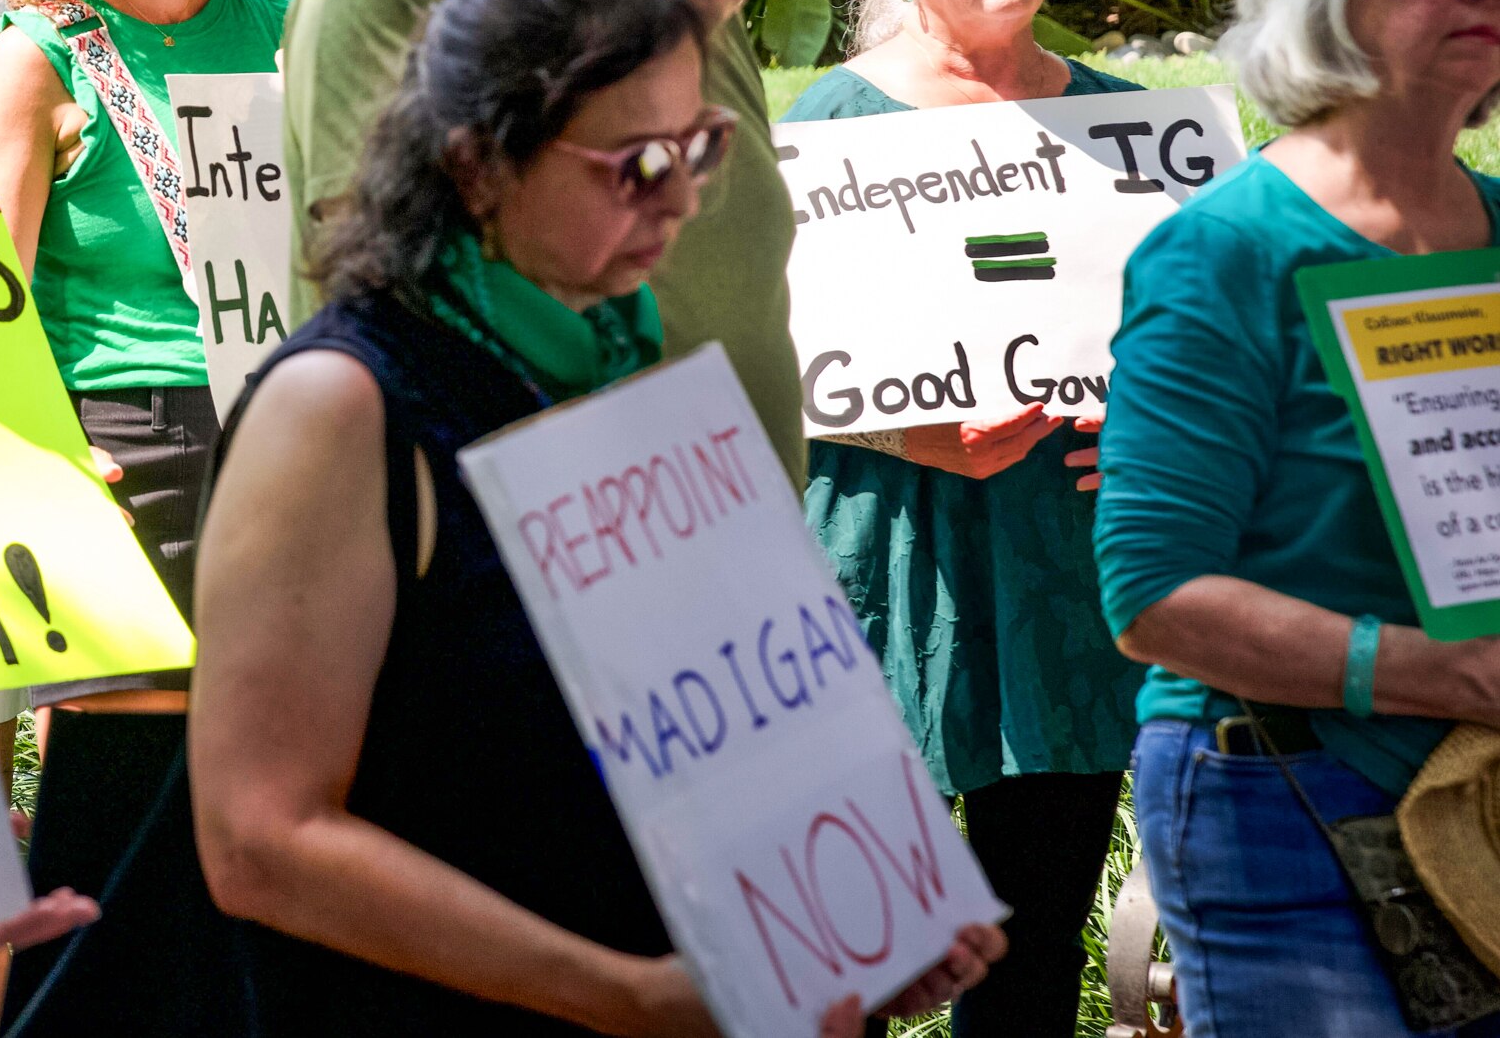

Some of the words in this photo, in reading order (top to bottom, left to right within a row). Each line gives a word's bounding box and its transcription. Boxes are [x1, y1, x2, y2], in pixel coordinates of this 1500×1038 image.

[177, 106, 281, 201] Inte
[1088, 119, 1214, 194] IG
[1376, 339, 1443, 365] RIGHT
[800, 340, 976, 428] Good
[1410, 428, 1455, 456] and
[1461, 429, 1500, 449] acc
[1444, 469, 1483, 493] the
[1436, 511, 1462, 538] of
[735, 753, 946, 1007] NOW
